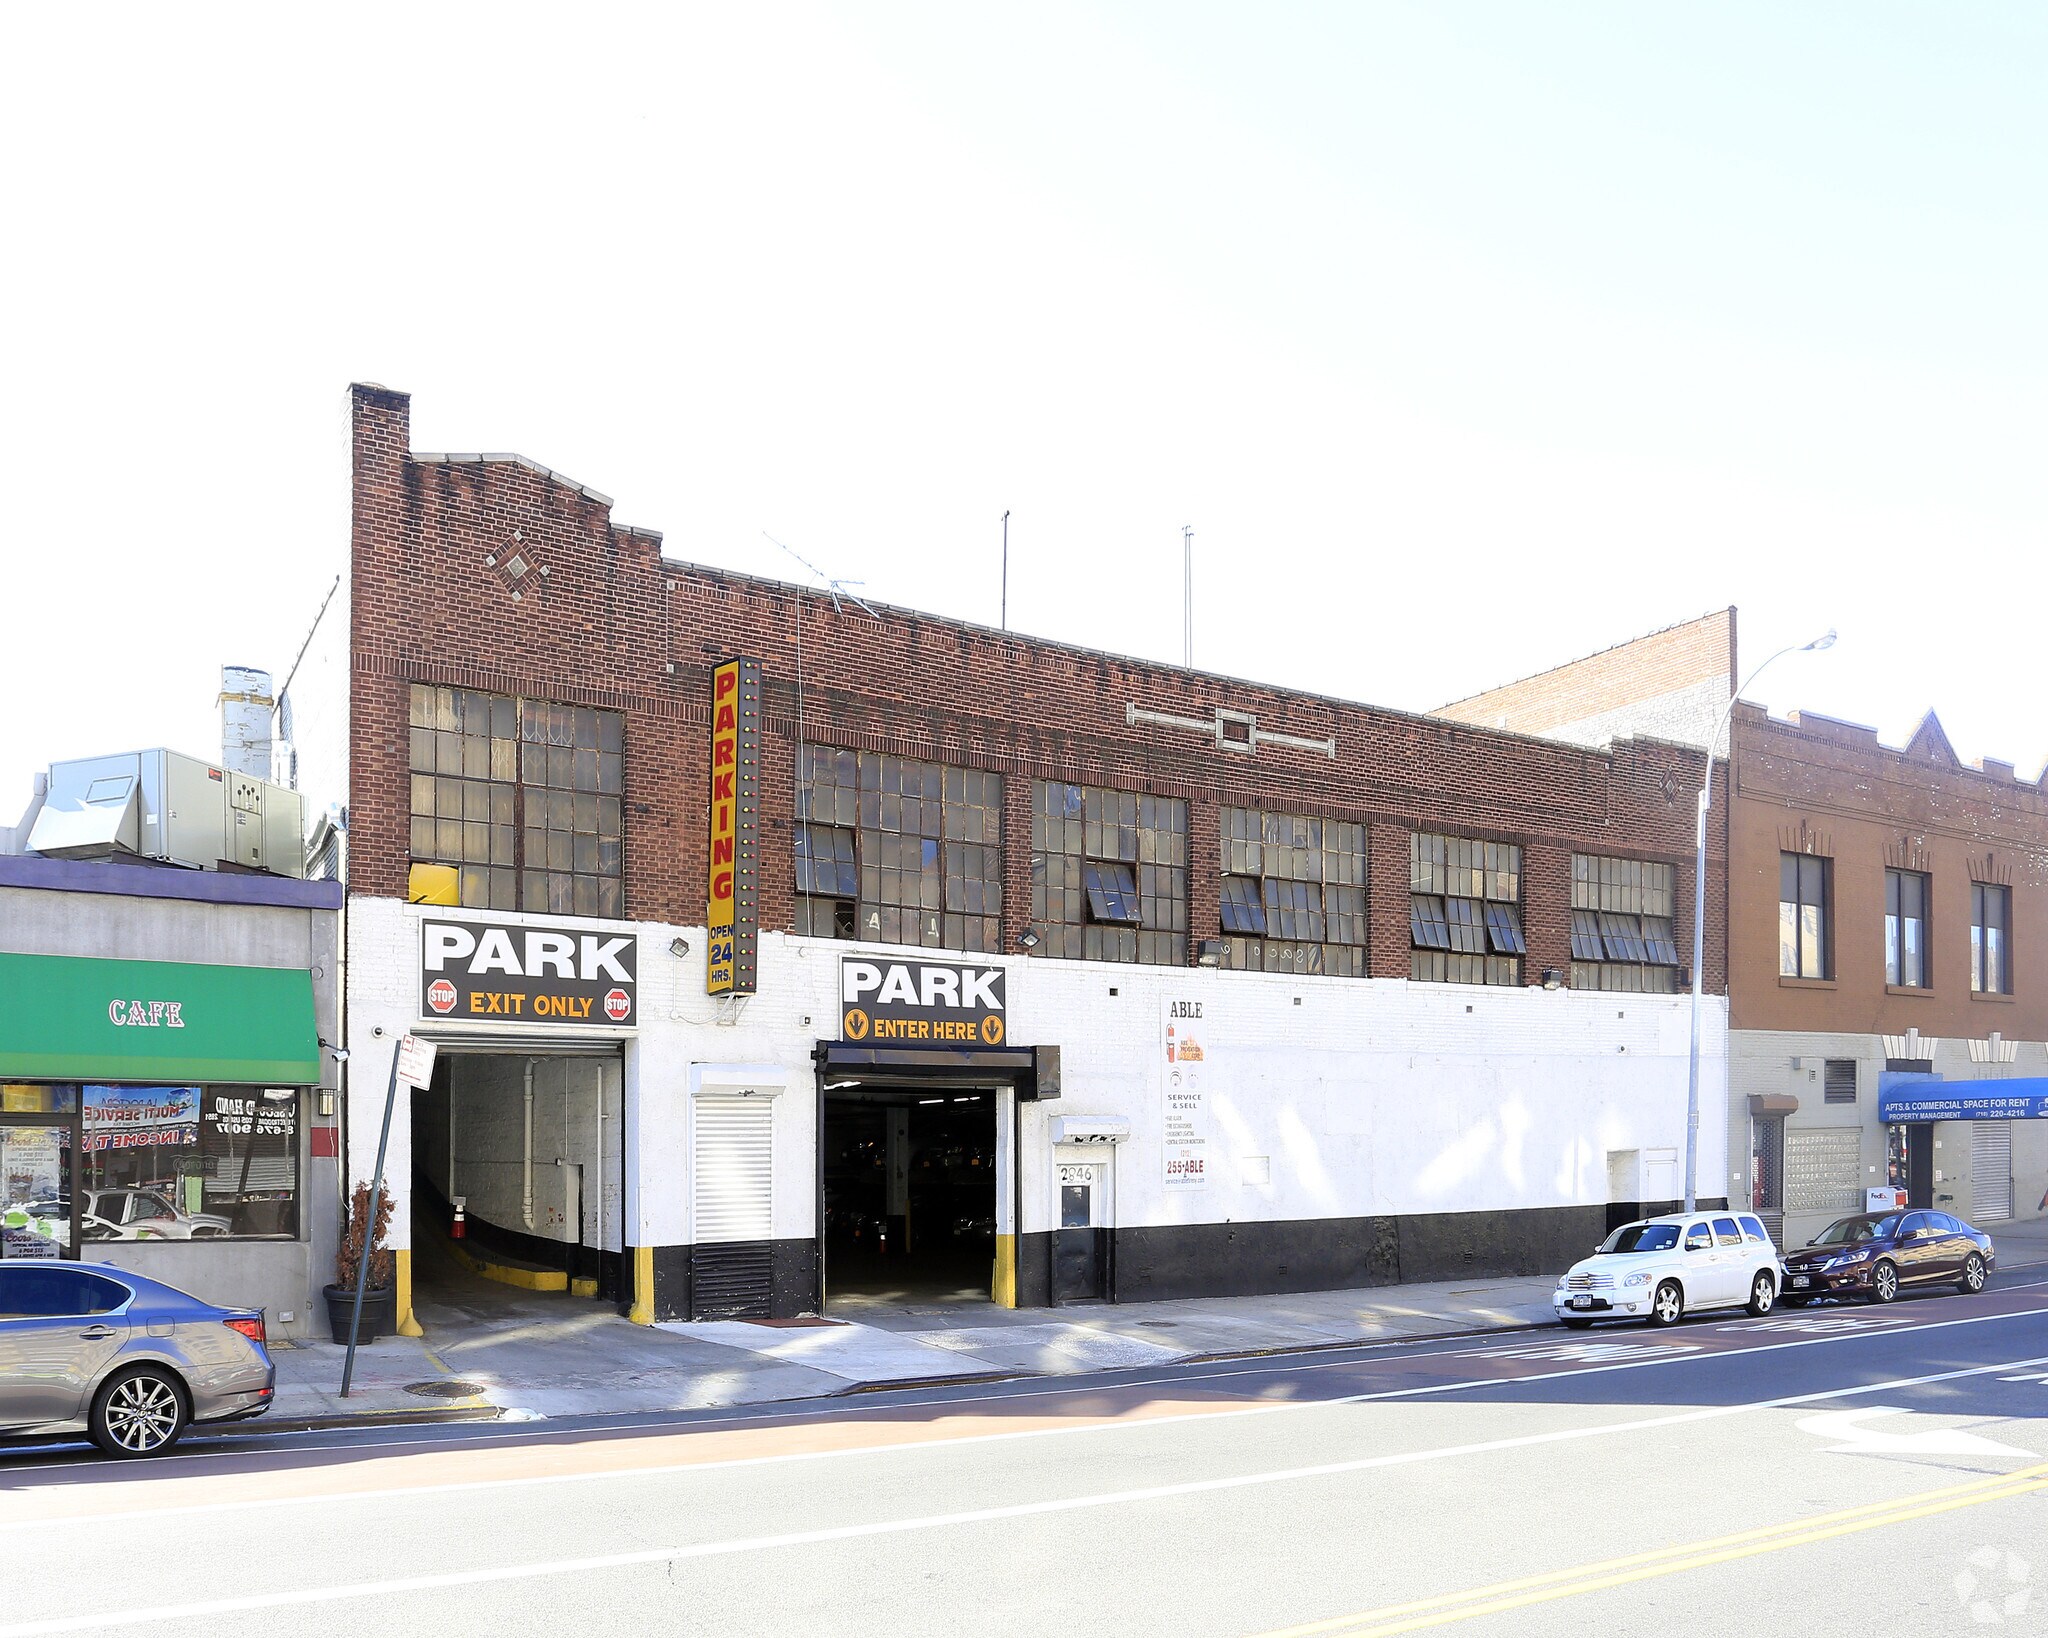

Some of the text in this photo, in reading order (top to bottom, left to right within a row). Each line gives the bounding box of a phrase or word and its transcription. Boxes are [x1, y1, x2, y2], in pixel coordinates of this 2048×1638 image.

[713, 671, 736, 900] PARKING
[710, 923, 734, 940] OPEN
[424, 923, 635, 983] PARK
[710, 942, 733, 966] 24
[711, 968, 731, 983] HRS.
[842, 961, 1004, 1010] PARK
[430, 989, 455, 1003] STOP
[470, 991, 594, 1018] EXIT ONLY
[606, 997, 629, 1011] STOP
[108, 999, 185, 1028] CAFE
[1170, 1001, 1203, 1019] ABLE
[874, 1018, 977, 1041] ENTER HERE
[1911, 1100, 1962, 1111] COMMERCIAL
[1963, 1099, 1989, 1109] SPACE
[1990, 1098, 2007, 1108] FOR
[2008, 1097, 2030, 1107] RENT
[1888, 1112, 1919, 1120] PROPERTY
[1920, 1111, 1961, 1119] MANAGEMENT
[1989, 1109, 2026, 1118] 220-4216
[1060, 1166, 1092, 1181] 2846
